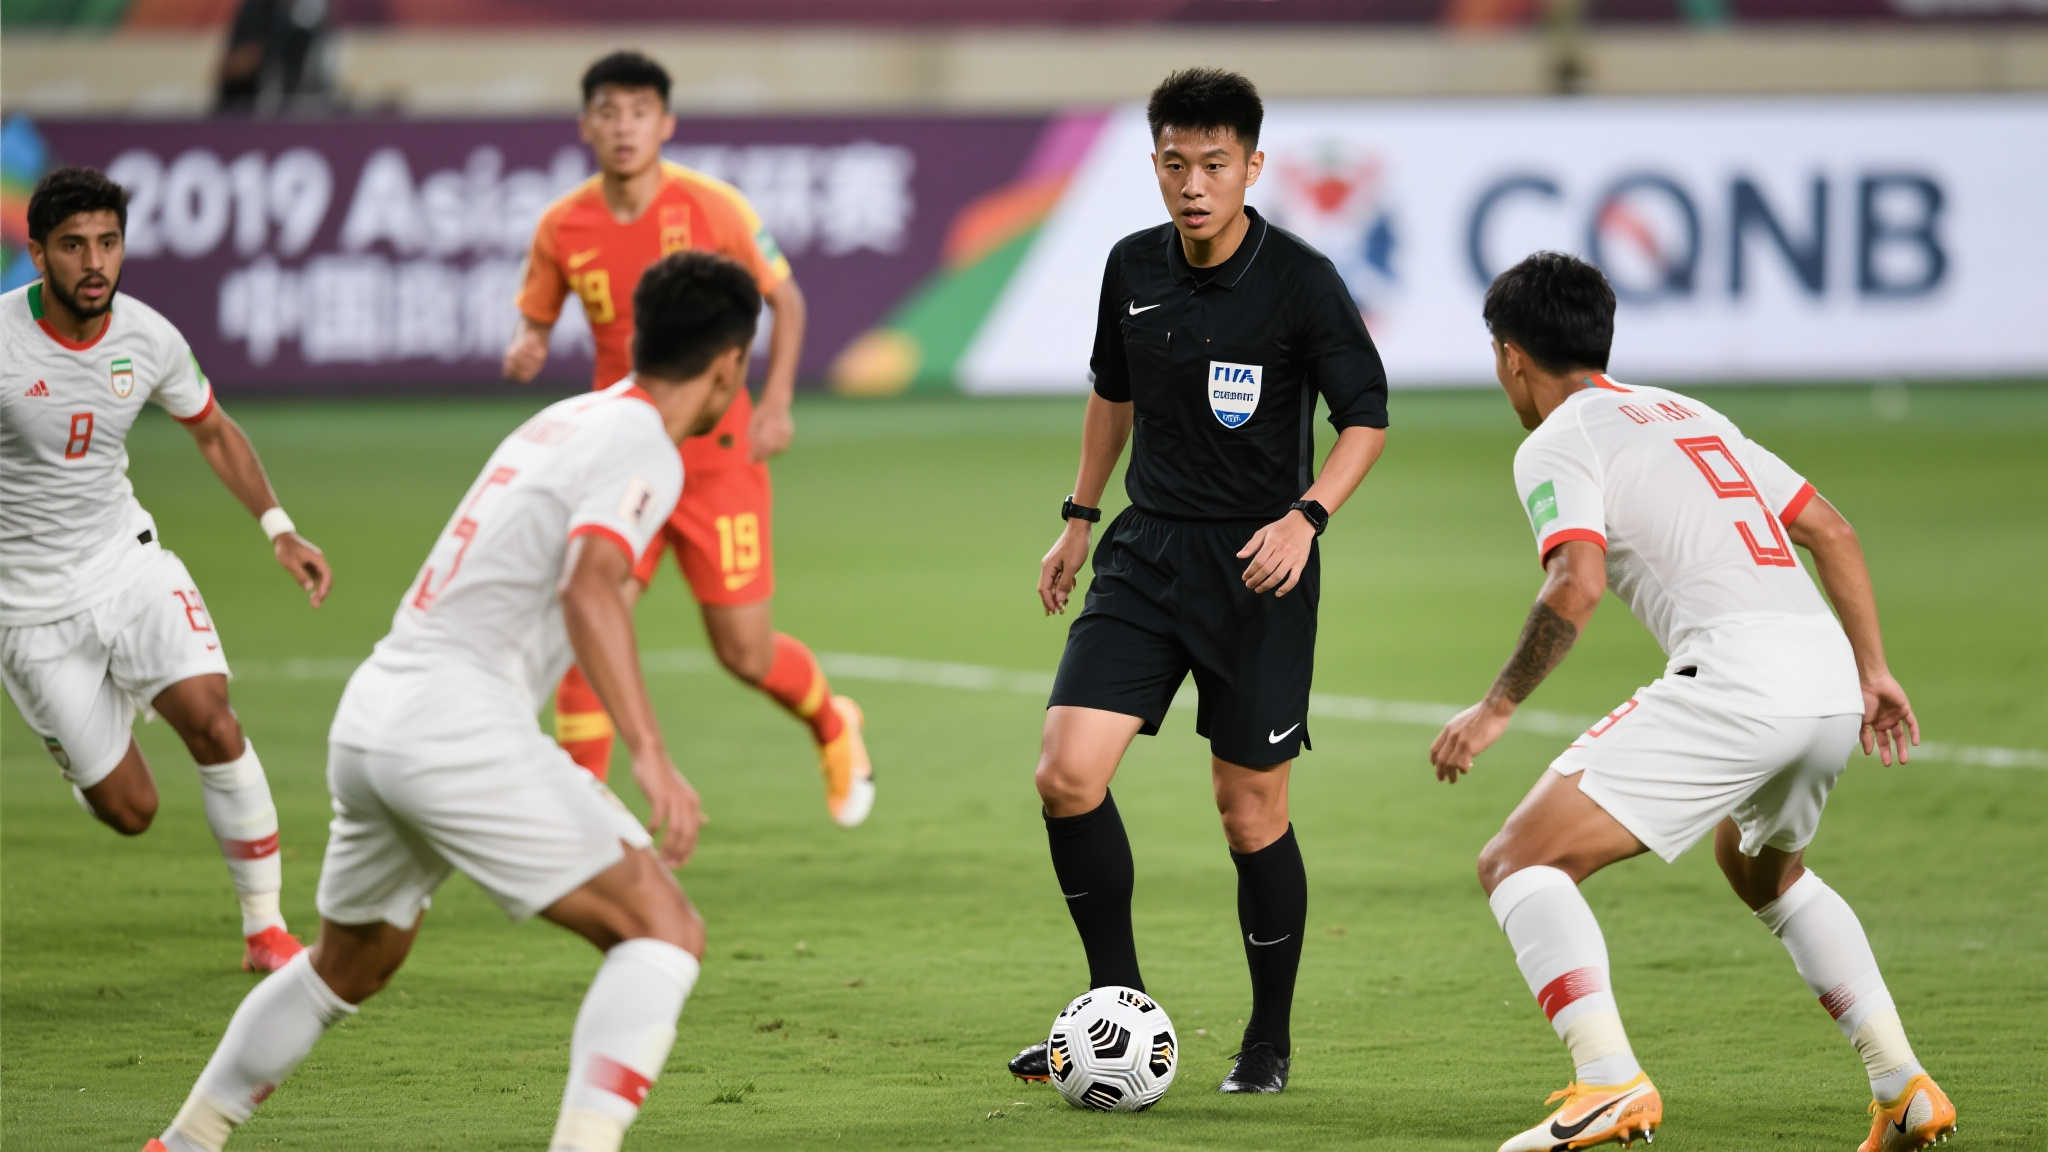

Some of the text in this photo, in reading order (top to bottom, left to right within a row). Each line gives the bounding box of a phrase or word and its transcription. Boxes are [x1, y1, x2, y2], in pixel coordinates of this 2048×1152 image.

[106, 147, 333, 259] 2019
[1466, 170, 1952, 300] CQNB
[65, 412, 94, 461] 8
[715, 512, 761, 573] 19
[1674, 435, 1797, 568] 9
